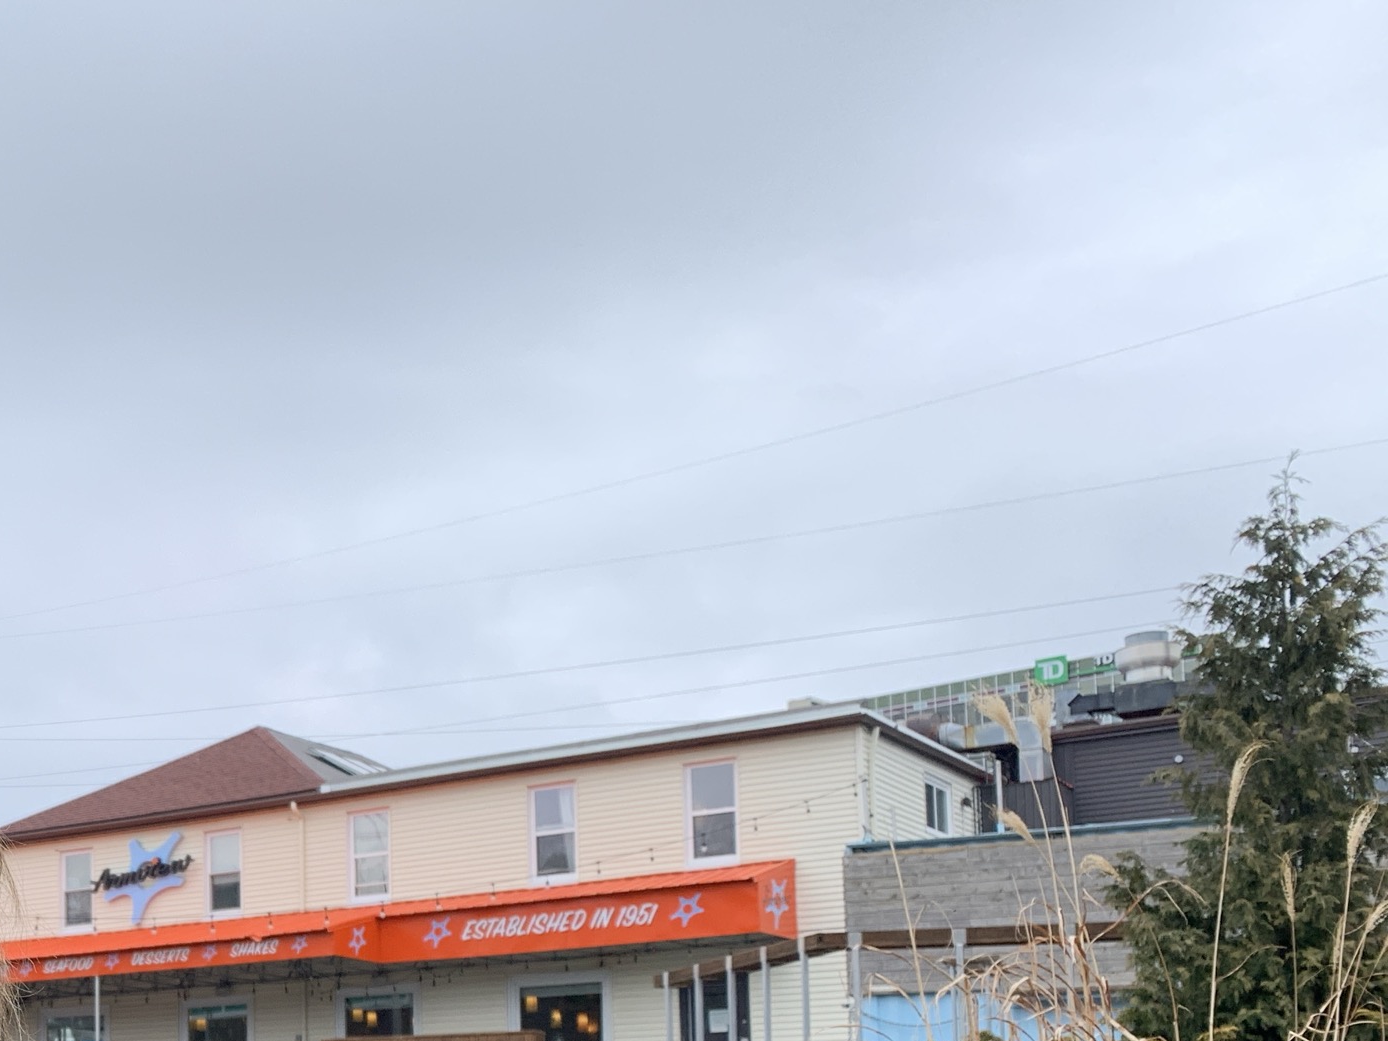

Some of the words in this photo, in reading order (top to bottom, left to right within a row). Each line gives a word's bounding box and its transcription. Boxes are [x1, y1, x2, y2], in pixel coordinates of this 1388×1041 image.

[1037, 660, 1065, 680] TD
[1094, 653, 1114, 667] TD
[461, 908, 587, 941] ESTABLISHED
[590, 907, 615, 929] IN
[615, 902, 659, 928] 1951
[43, 957, 94, 975] SEAFOOD
[131, 948, 190, 966] DESSERTS
[229, 939, 280, 959] SHAKES
